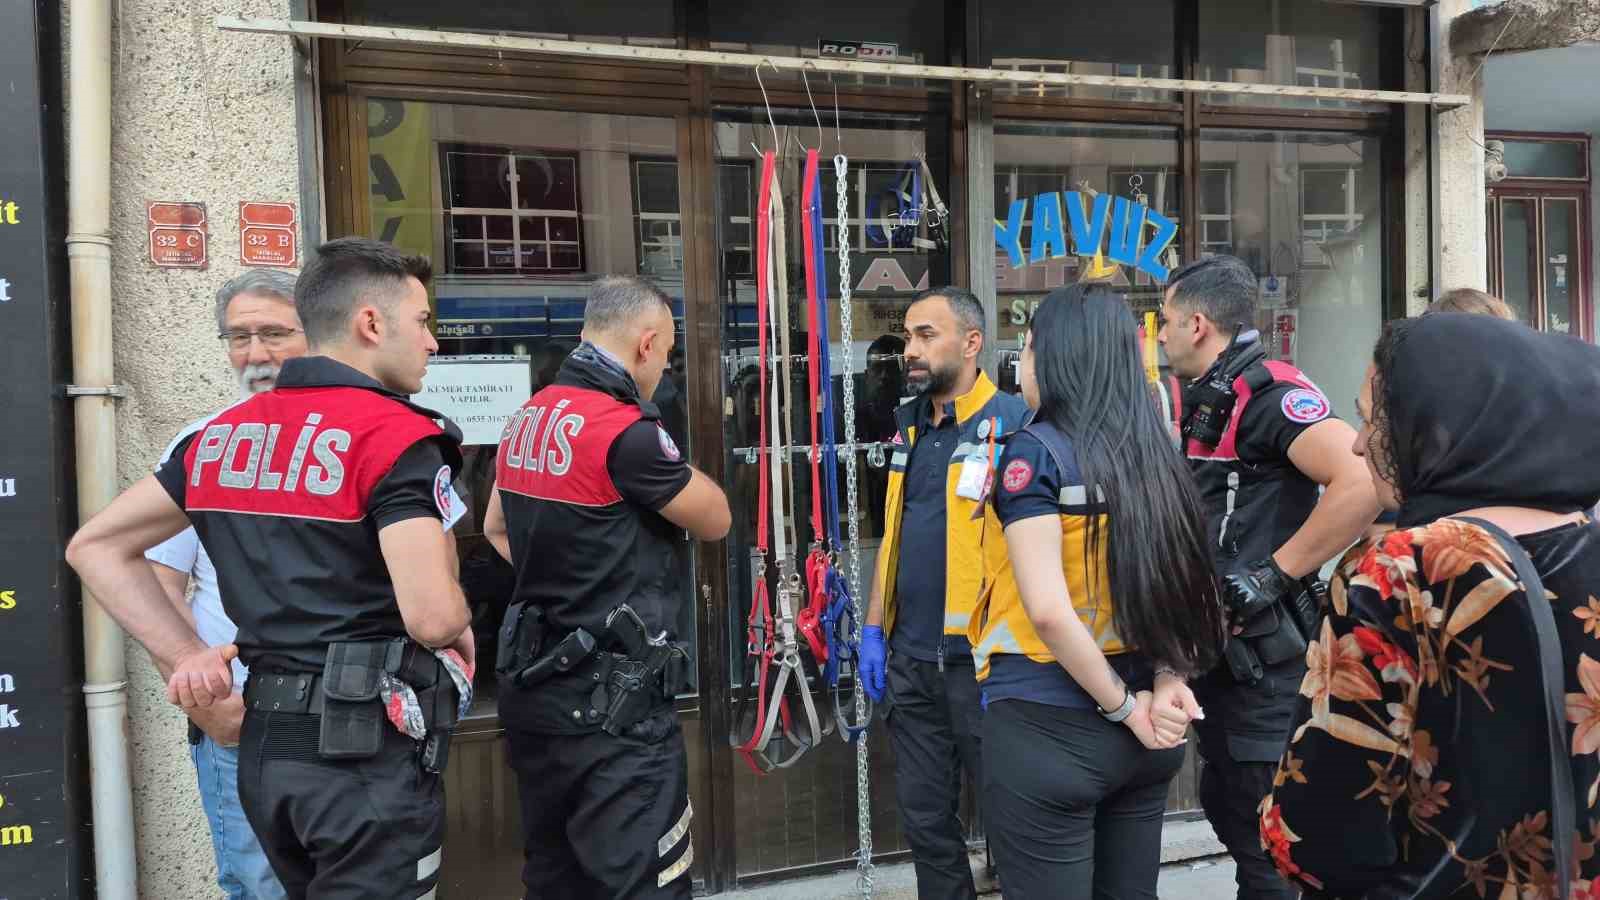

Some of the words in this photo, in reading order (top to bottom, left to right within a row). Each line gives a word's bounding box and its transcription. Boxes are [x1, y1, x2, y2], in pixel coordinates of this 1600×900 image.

[156, 235, 177, 247] 32
[186, 235, 199, 247] C
[248, 234, 267, 246] 32
[279, 235, 289, 247] B
[993, 191, 1179, 282] YAVUZ
[427, 384, 463, 393] KEMER
[191, 413, 351, 495] POLİS
[500, 399, 585, 476] POLİS
